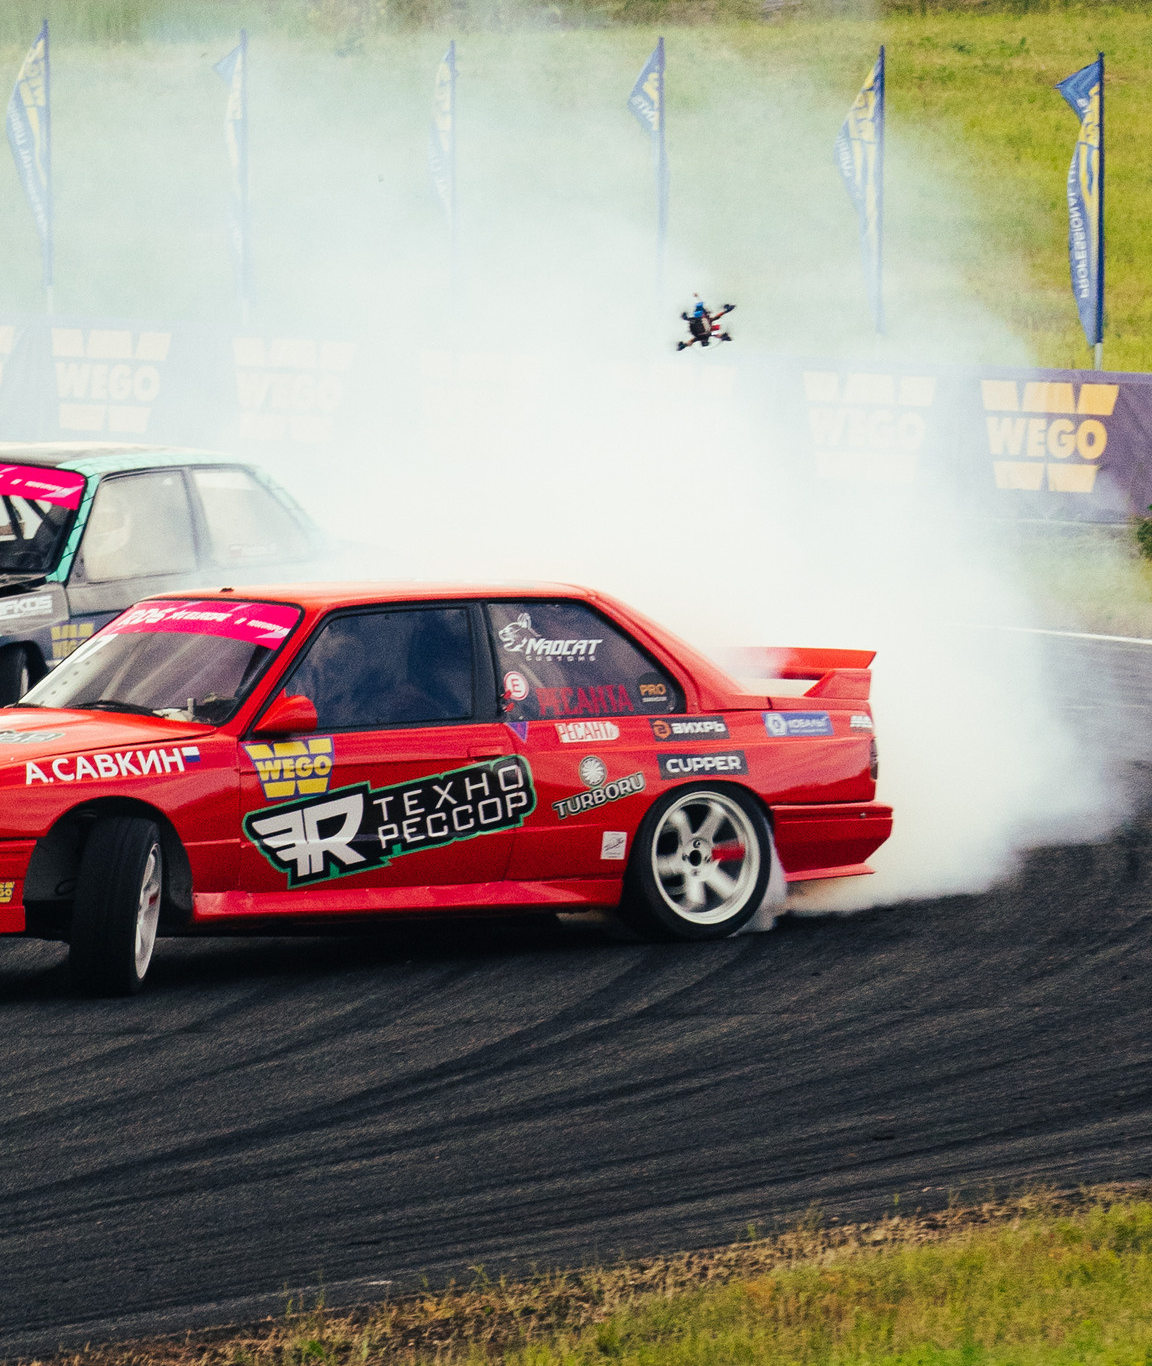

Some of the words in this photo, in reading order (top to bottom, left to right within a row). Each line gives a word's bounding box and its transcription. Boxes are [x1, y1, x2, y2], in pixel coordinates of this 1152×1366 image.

[55, 362, 160, 402] WEGO
[809, 409, 925, 450] WEGO
[985, 417, 1107, 459] WEGO
[117, 608, 177, 626] RDS
[525, 638, 604, 656] MADCAT
[511, 678, 522, 693] E
[535, 684, 635, 715] РЕСАНТА
[639, 683, 667, 696] PRO
[25, 747, 186, 785] А.САВКИН
[255, 755, 333, 781] WEGO
[665, 755, 742, 773] CUPPER
[373, 764, 525, 821] ТЕХНО
[553, 772, 645, 817] TURBORU
[378, 791, 528, 849] РЕССОР
